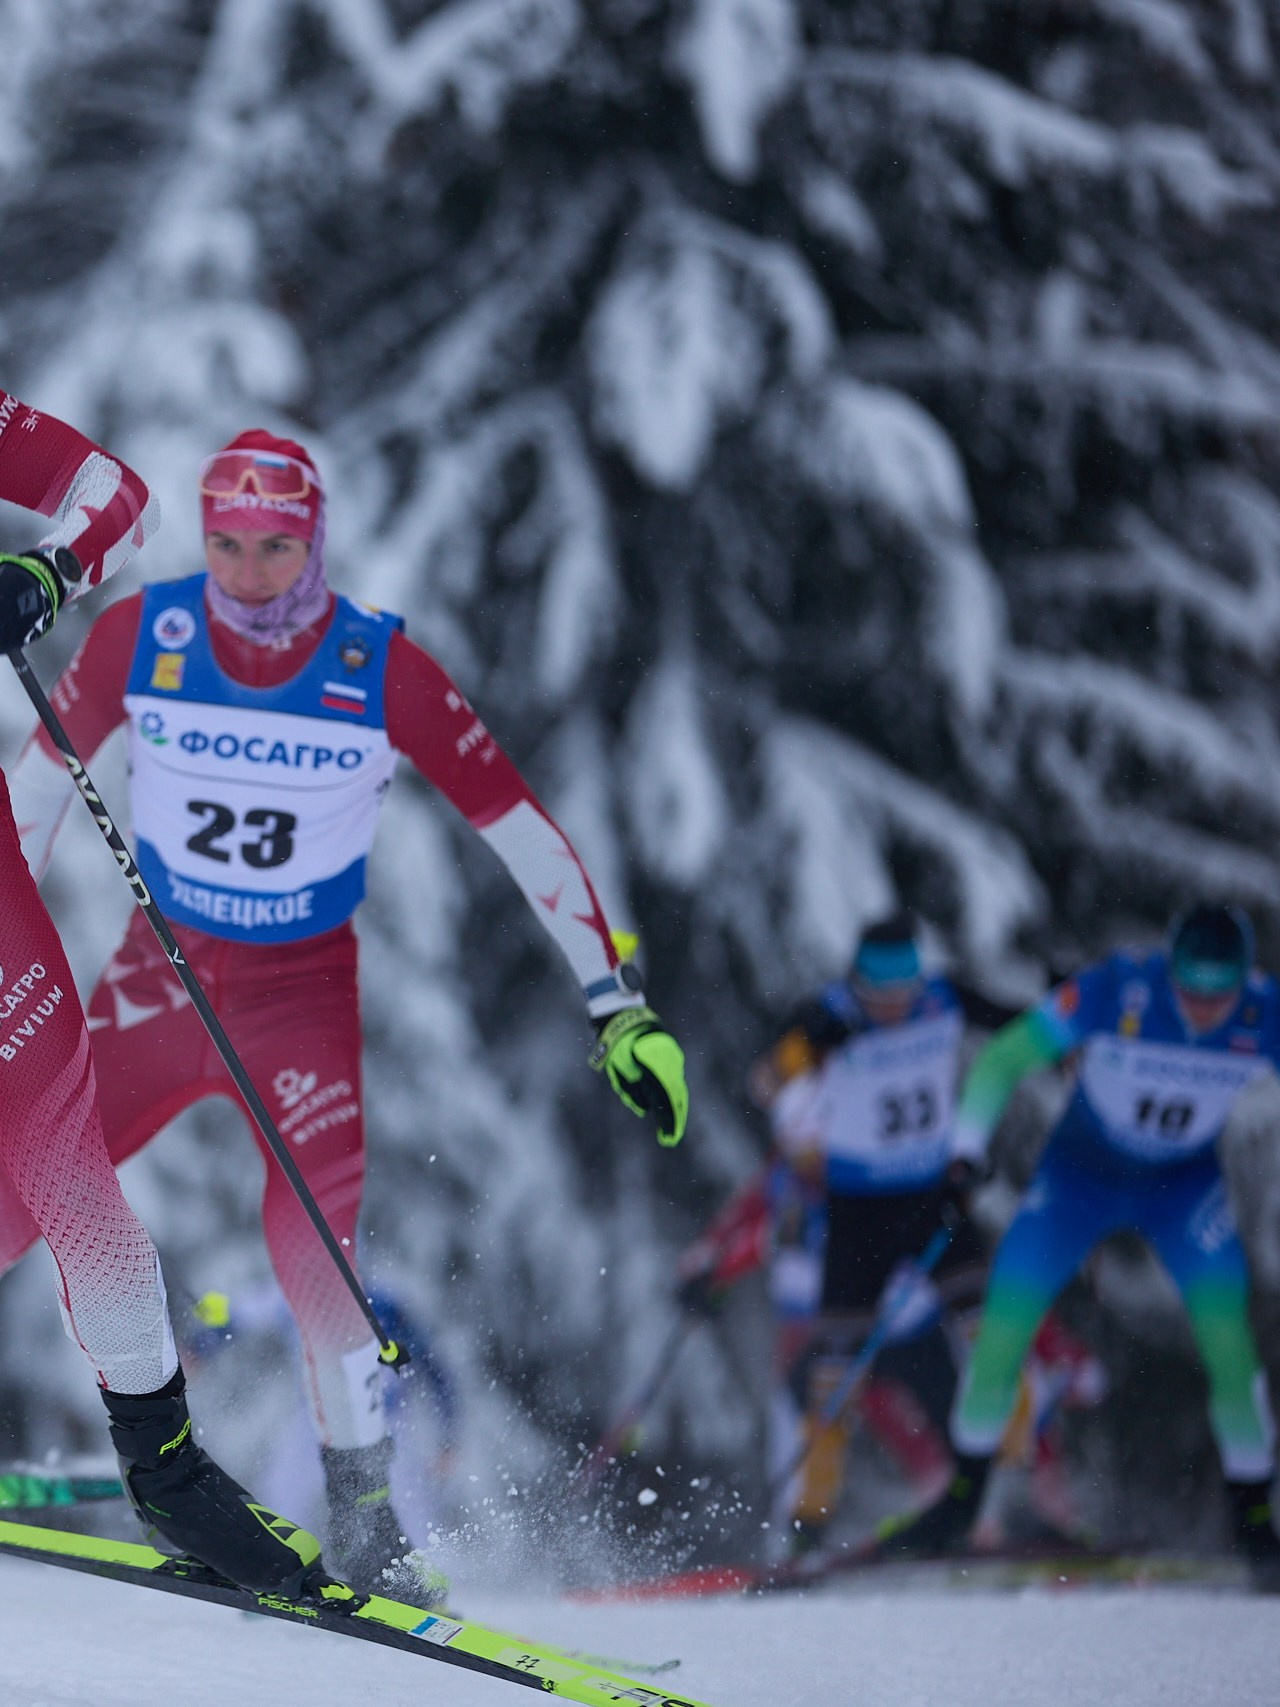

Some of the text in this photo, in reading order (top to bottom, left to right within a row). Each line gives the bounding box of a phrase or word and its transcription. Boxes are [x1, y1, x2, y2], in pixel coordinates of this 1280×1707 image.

[179, 730, 363, 770] ФОСАГРО
[185, 799, 297, 868] 23
[257, 1597, 319, 1618] FISCHER
